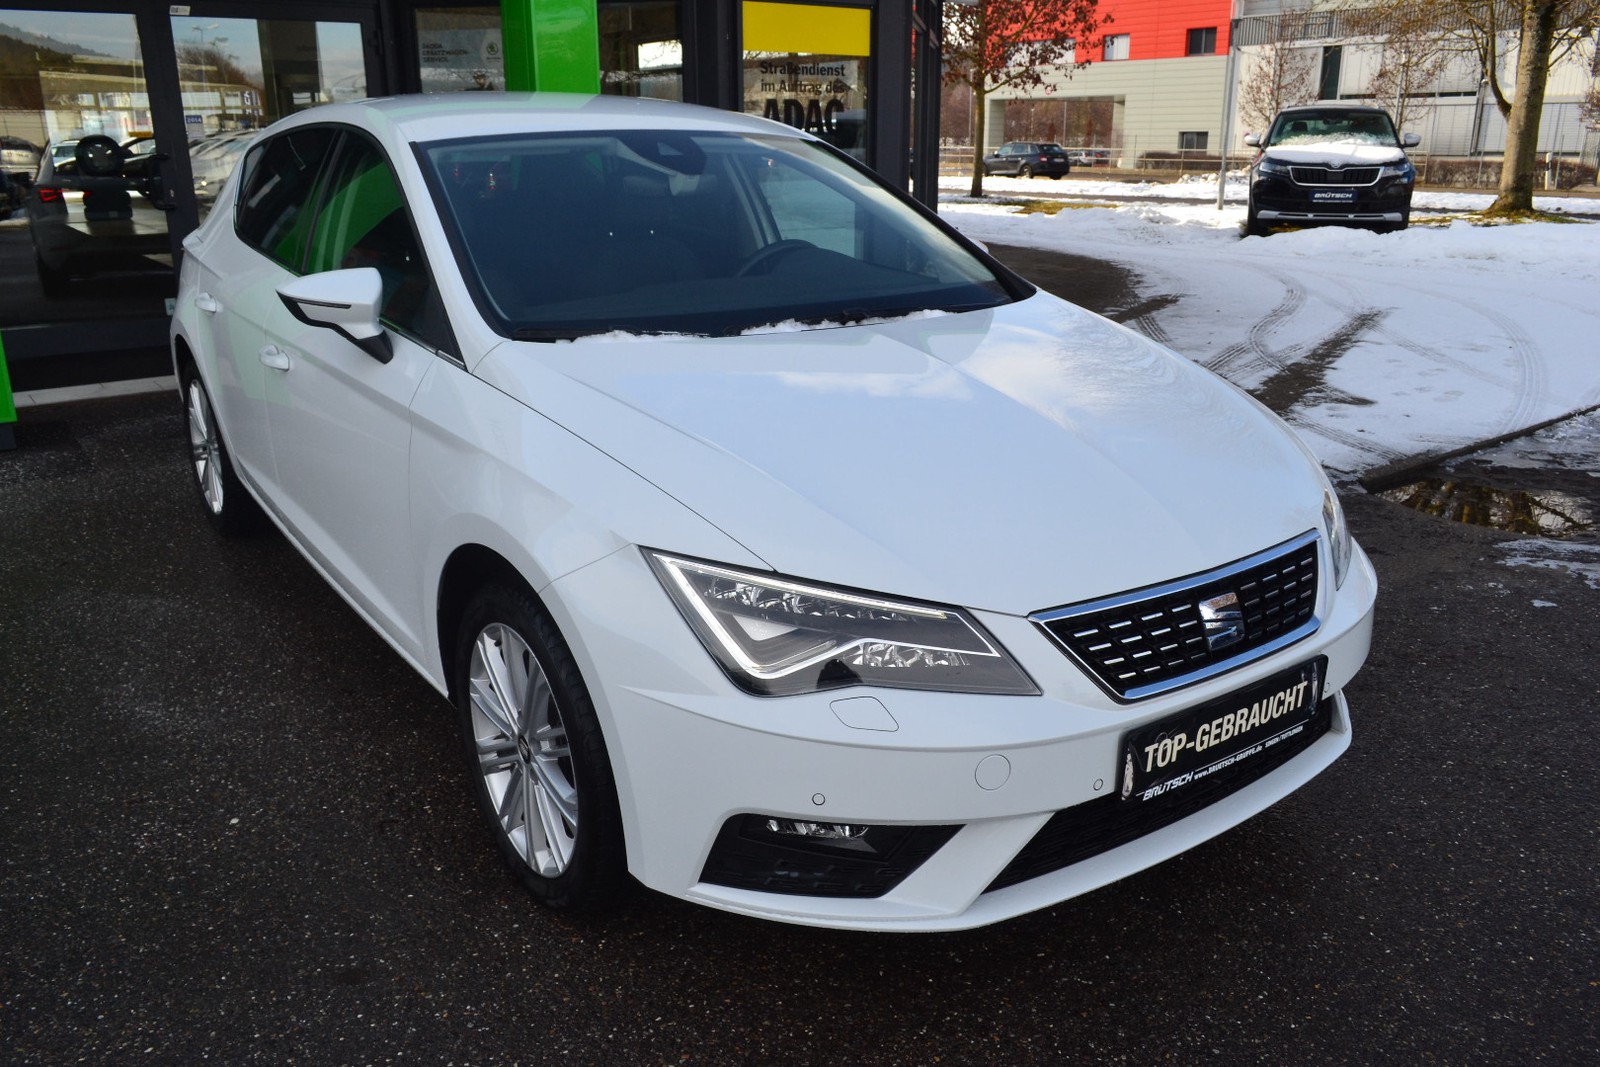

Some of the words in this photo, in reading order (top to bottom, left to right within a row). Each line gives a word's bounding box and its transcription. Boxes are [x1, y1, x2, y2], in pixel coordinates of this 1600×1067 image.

[760, 61, 845, 77] Straßendienst
[760, 79, 775, 92] im
[779, 80, 823, 95] Auftrag
[826, 81, 845, 93] des
[763, 98, 845, 133] ADAC
[1144, 681, 1308, 773] TOP-GEBRAUCHT
[1142, 771, 1194, 802] BRÜTSCH
